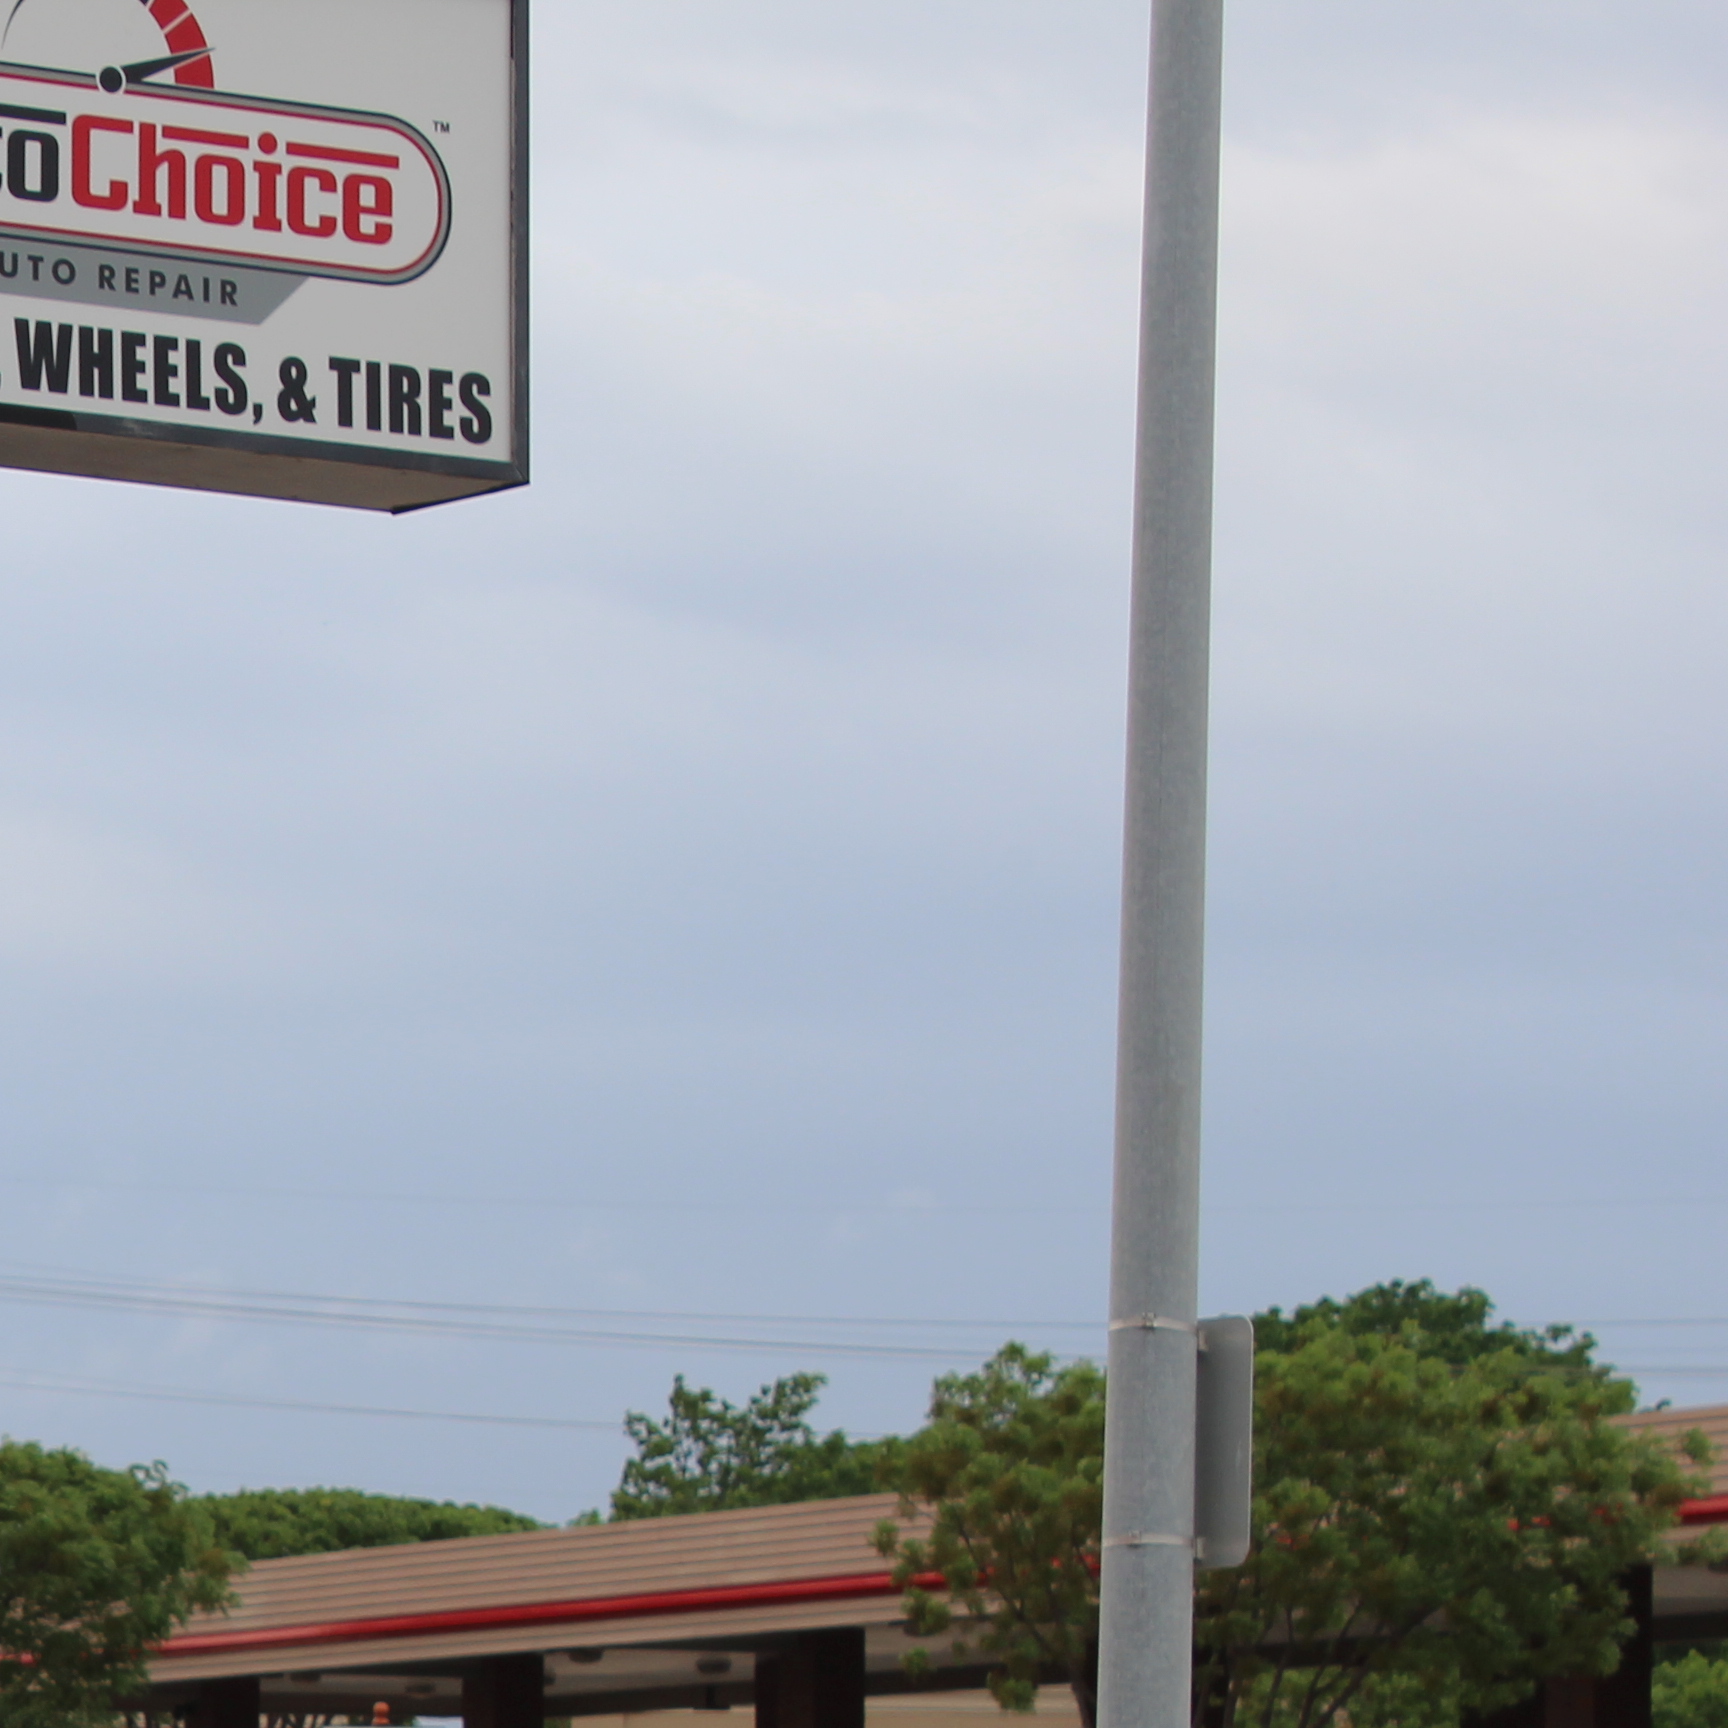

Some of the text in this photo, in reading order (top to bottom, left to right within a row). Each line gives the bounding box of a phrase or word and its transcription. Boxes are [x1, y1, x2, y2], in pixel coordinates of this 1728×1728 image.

[432, 119, 450, 134] TM
[97, 263, 238, 306] REPAIR
[13, 317, 264, 425] WHEELS,
[276, 355, 318, 424] &
[328, 355, 493, 445] TIRES
